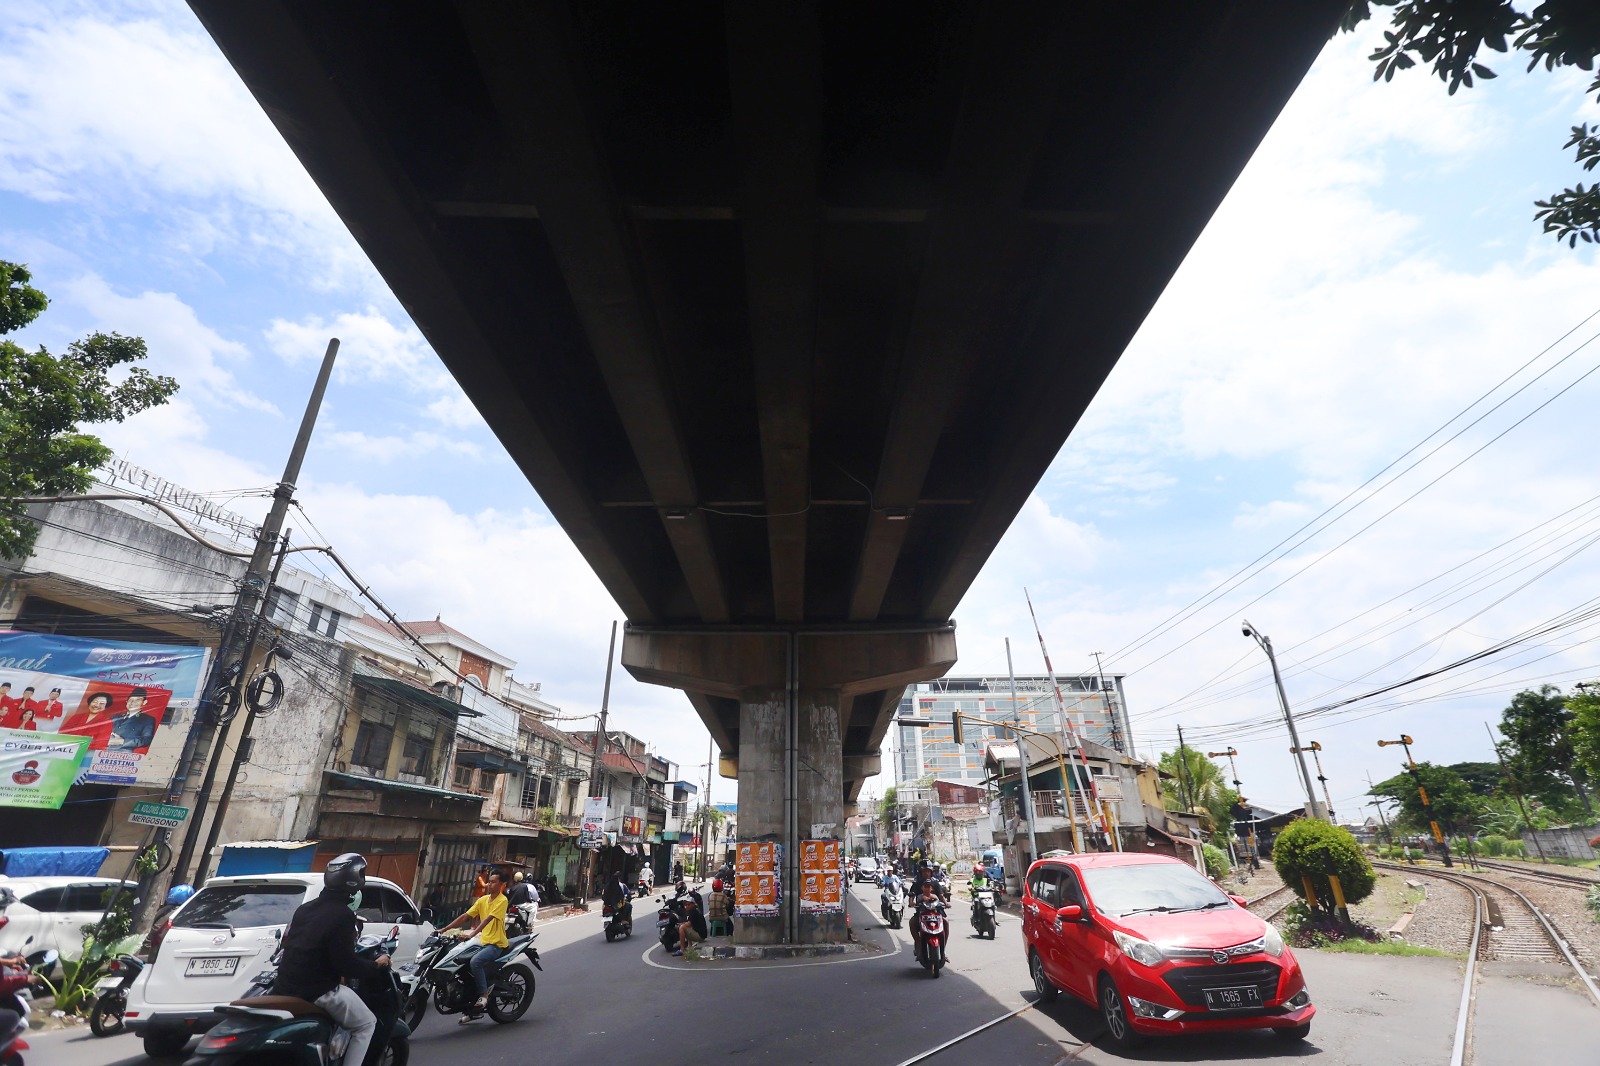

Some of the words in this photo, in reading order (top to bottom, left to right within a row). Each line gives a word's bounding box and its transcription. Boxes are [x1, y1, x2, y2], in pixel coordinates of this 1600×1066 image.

[105, 455, 167, 496] ANTI
[97, 671, 155, 681] SPARK
[5, 742, 42, 751] CYBER
[45, 746, 74, 754] MALL
[99, 759, 135, 767] KRISTINA
[131, 815, 178, 827] MERGOSONO
[190, 960, 196, 969] N
[225, 959, 236, 969] EU
[1207, 993, 1213, 1003] N
[1220, 990, 1241, 1002] 1565
[1247, 989, 1259, 1000] FX
